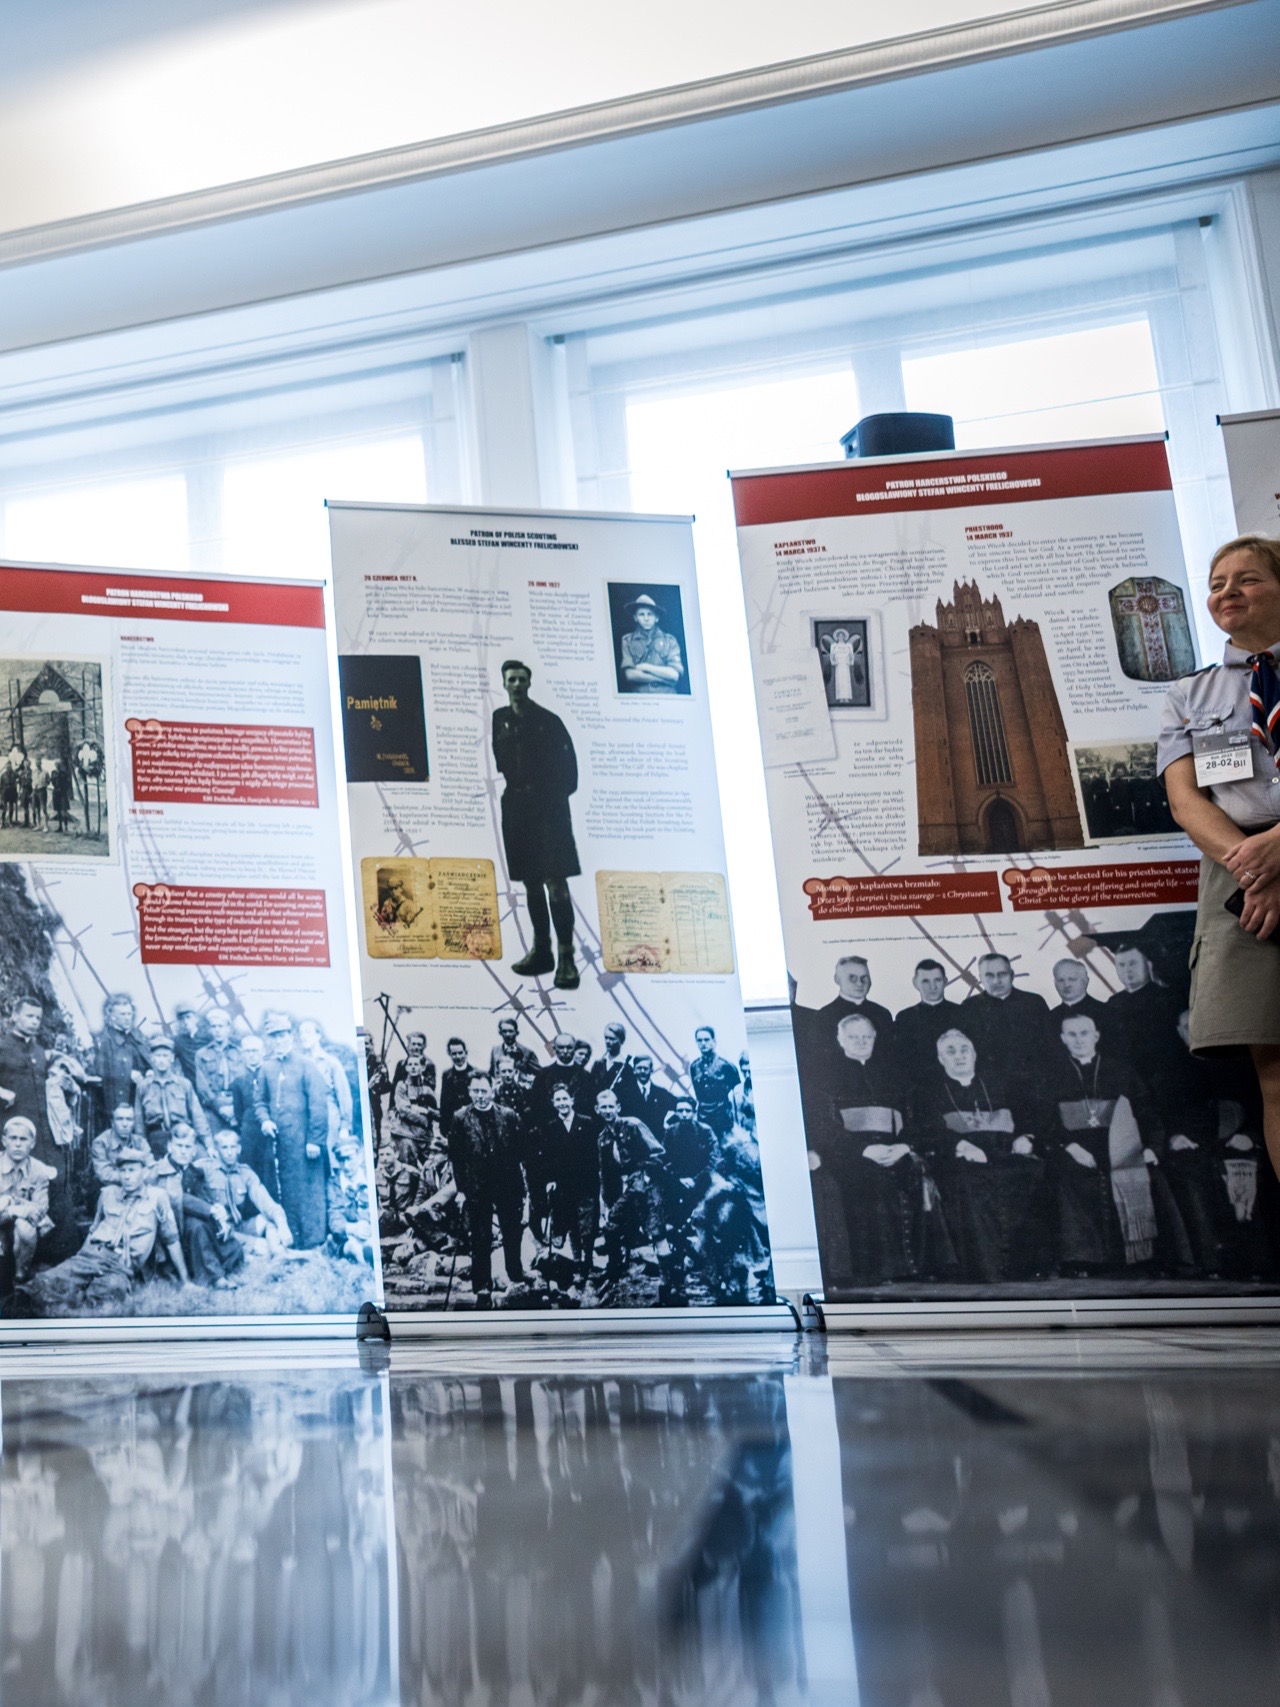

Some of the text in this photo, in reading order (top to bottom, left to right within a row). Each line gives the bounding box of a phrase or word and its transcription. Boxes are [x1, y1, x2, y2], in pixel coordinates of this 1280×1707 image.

[886, 472, 1007, 490] PATRON HARCERSTWA POLSKIEGO
[918, 487, 944, 497] STEFAN
[946, 483, 984, 495] WINCENTY
[470, 530, 493, 538] PATRON
[503, 531, 525, 539] POLISH
[526, 532, 557, 540] SCOUTING
[500, 540, 532, 548] WINCENTY
[347, 696, 398, 711] Pamiętnik
[1206, 758, 1232, 769] 28-02
[1068, 871, 1100, 880] selected
[859, 881, 903, 891] kapłaństwa
[904, 880, 941, 888] brzmiało:
[1091, 882, 1123, 892] suffering
[1140, 880, 1164, 890] simple
[1166, 879, 1178, 888] life
[1071, 894, 1089, 903] glory
[1090, 893, 1098, 902] of
